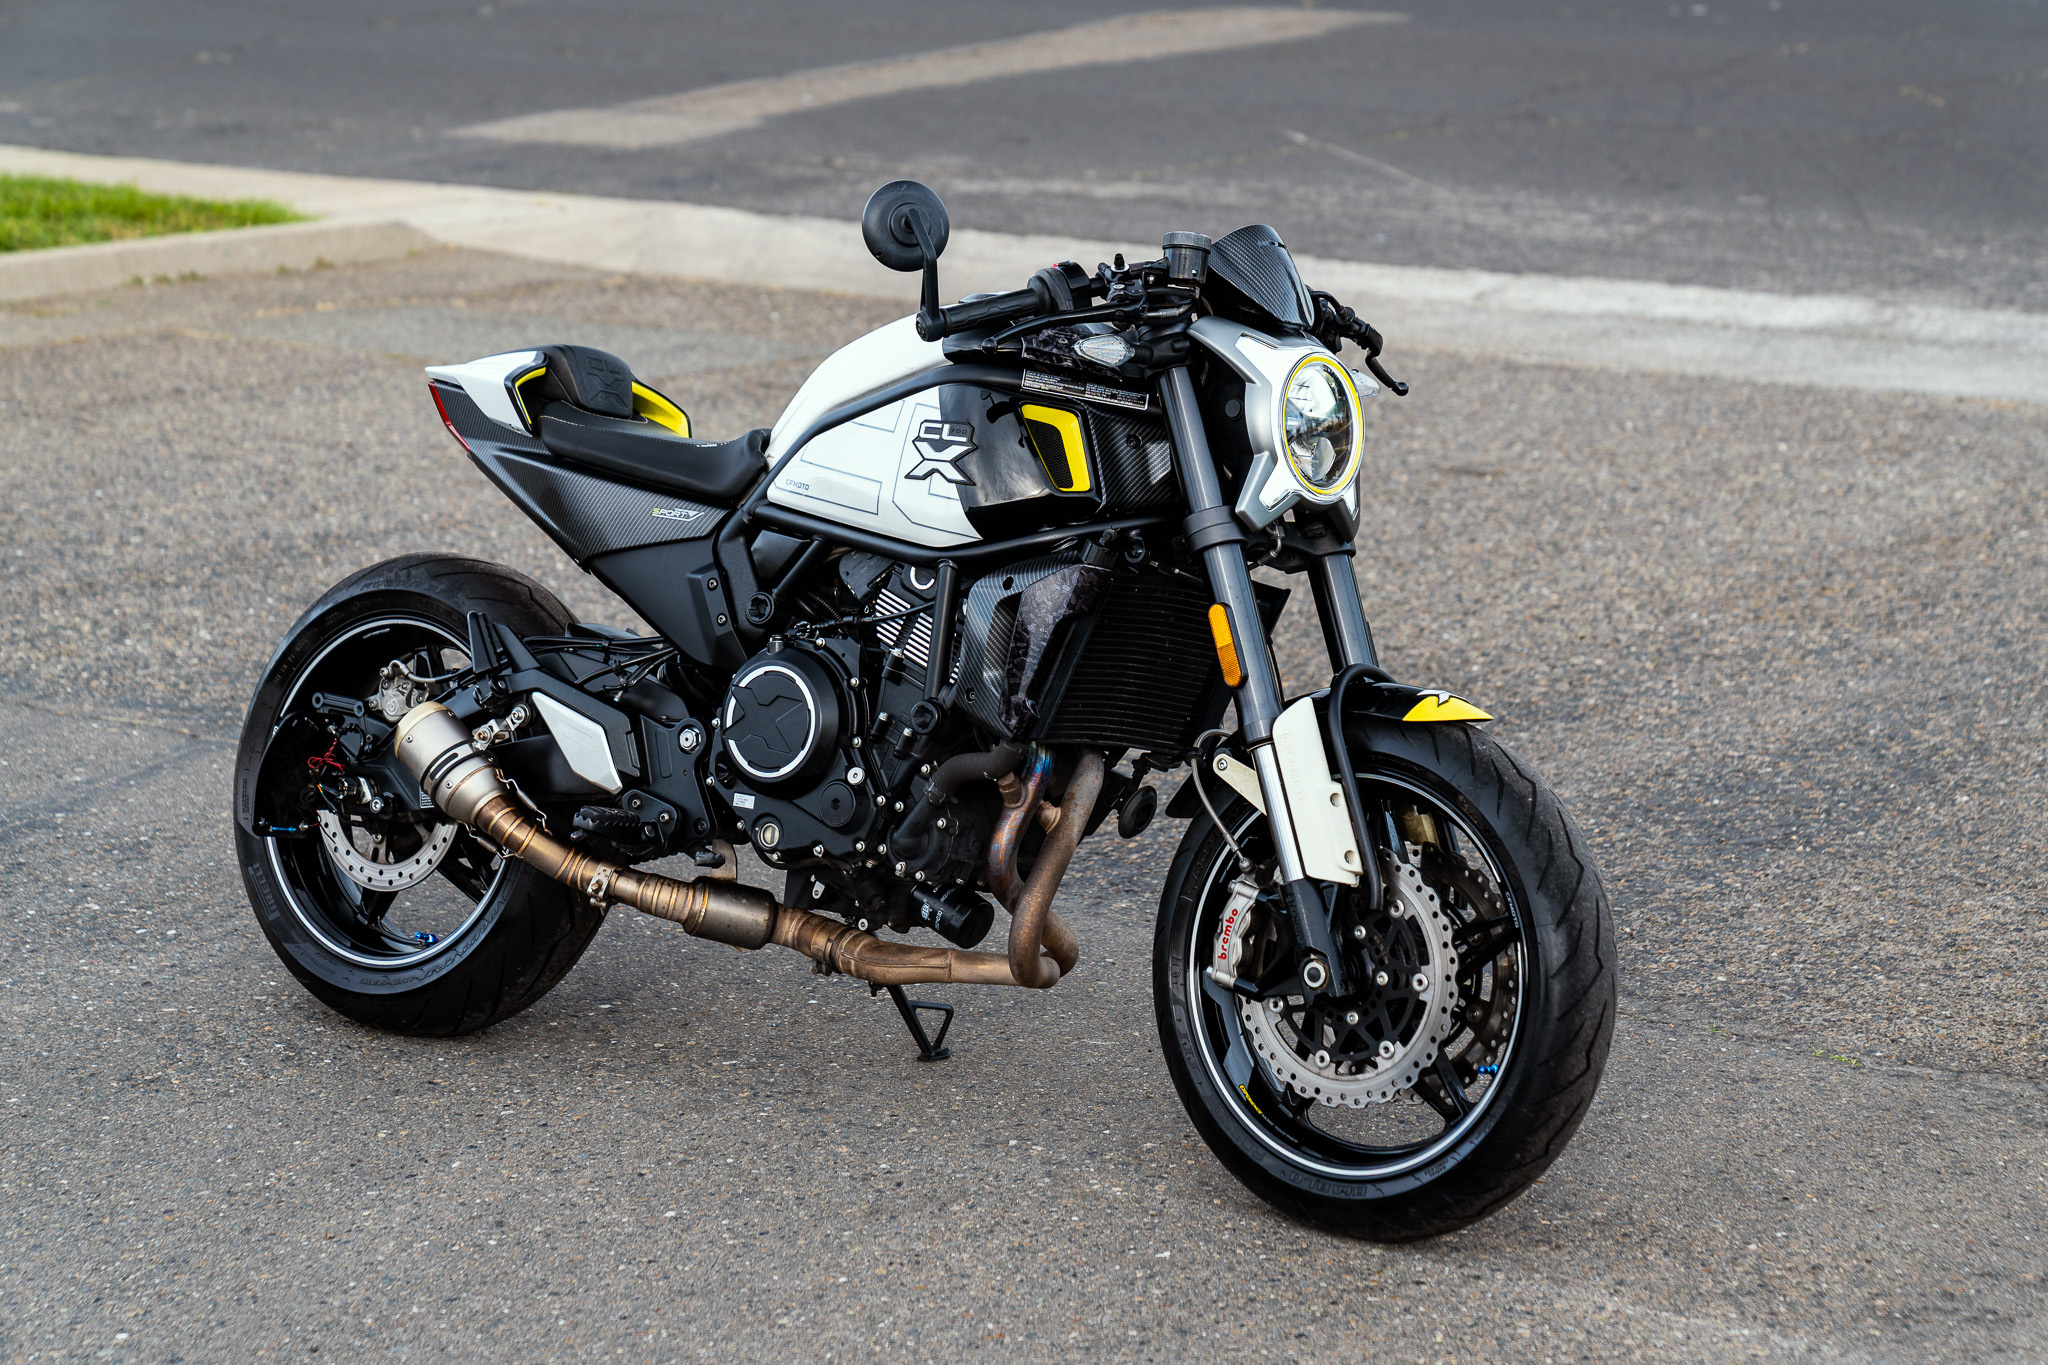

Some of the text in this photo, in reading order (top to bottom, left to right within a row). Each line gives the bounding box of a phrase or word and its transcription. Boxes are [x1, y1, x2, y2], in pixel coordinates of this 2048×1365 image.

[785, 477, 810, 491] CFMOTO
[652, 507, 689, 518] SPORT
[247, 862, 280, 922] PIRELLI
[1505, 891, 1519, 929] CFMOTO
[1217, 908, 1239, 961] brembo
[1211, 1103, 1267, 1162] ROSSO
[1289, 1170, 1368, 1198] DIABLO
